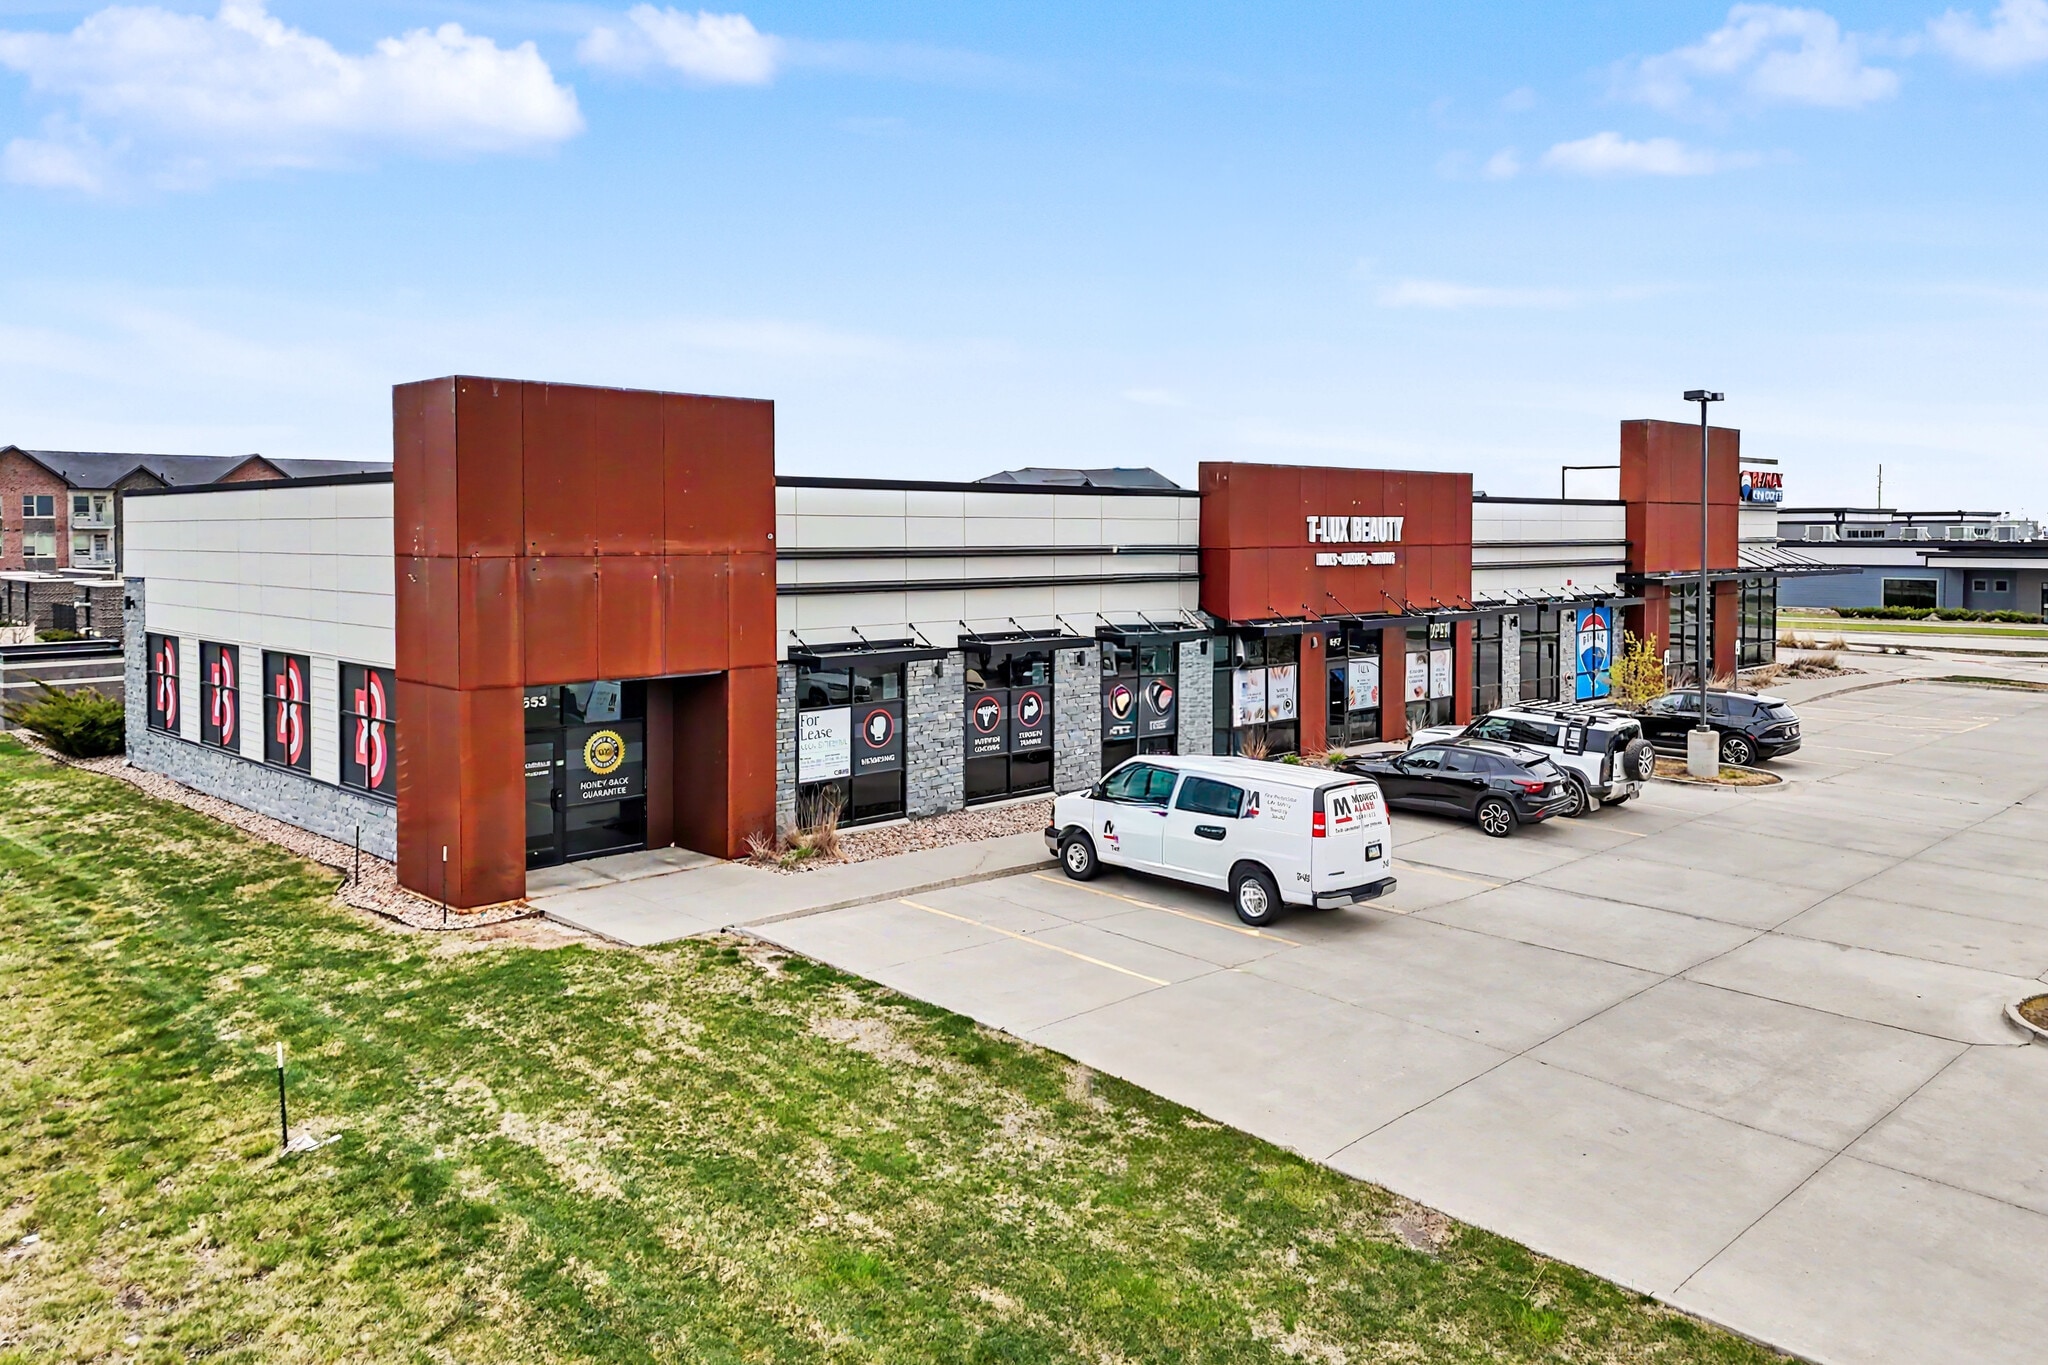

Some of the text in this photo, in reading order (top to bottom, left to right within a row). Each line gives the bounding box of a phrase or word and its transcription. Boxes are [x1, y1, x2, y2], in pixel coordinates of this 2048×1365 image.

[1306, 515, 1404, 543] T-LUX BEAUTY
[800, 714, 820, 728] For
[800, 728, 833, 741] Lease
